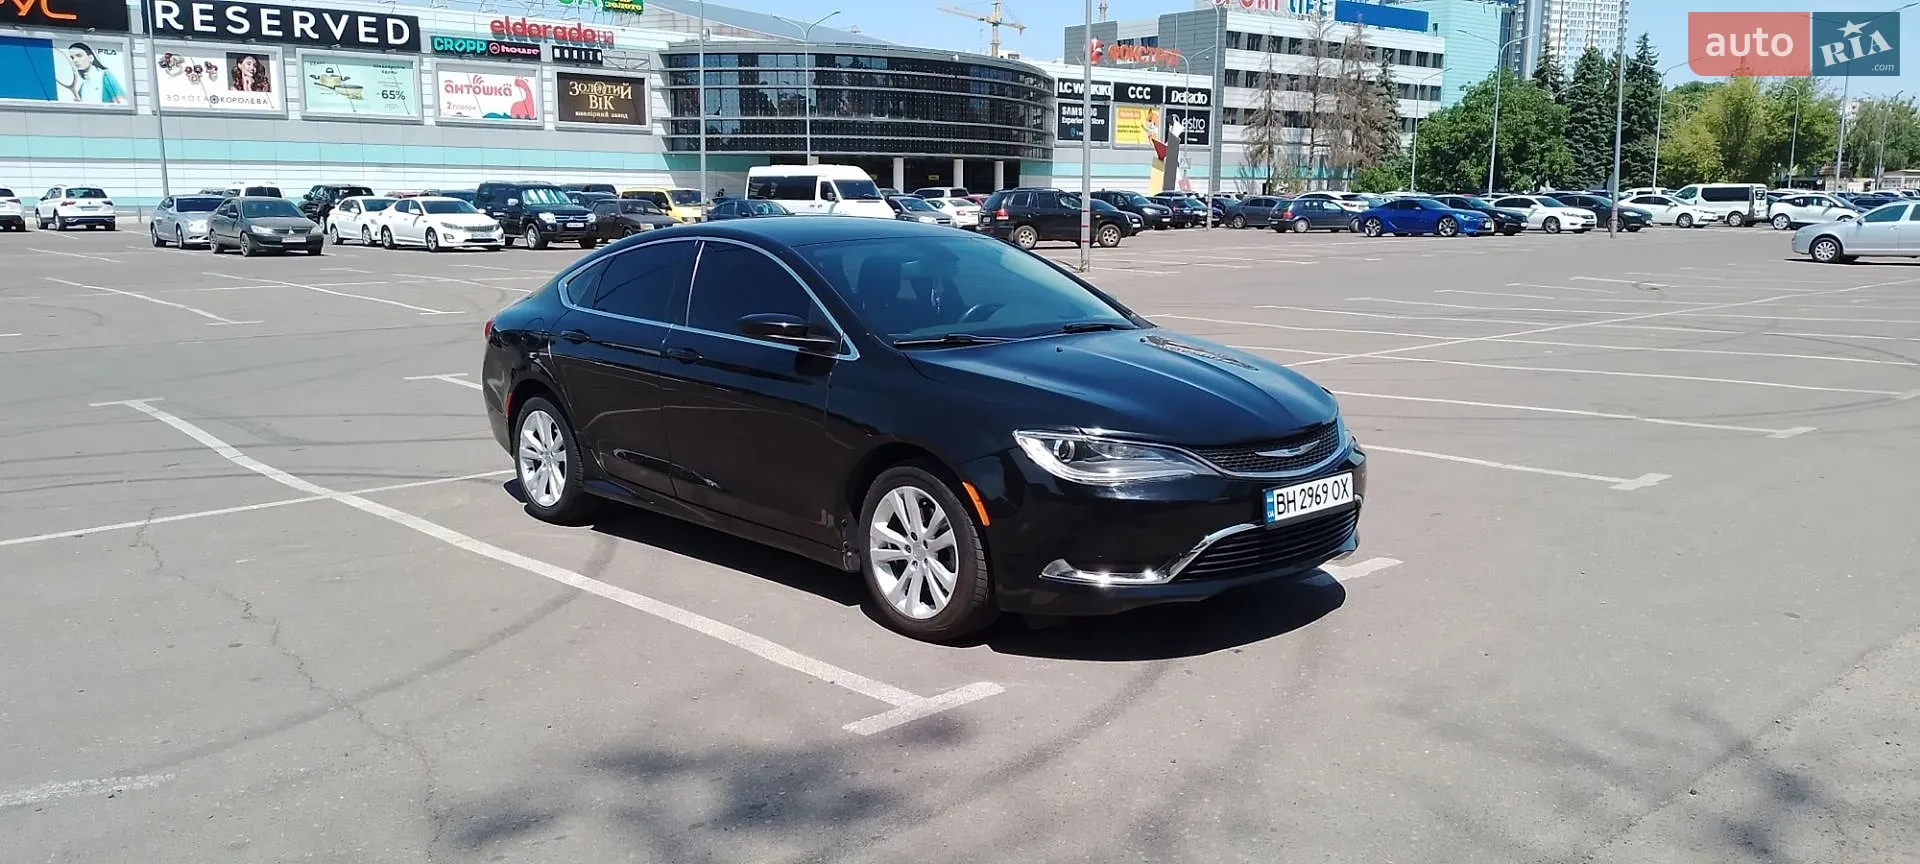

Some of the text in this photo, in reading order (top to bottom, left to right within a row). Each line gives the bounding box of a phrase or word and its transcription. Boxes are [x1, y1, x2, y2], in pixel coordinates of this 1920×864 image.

[155, 0, 411, 45] RESERVED
[433, 37, 487, 54] CROPP
[501, 45, 539, 55] house
[1059, 82, 1111, 96] LC WKIKI
[1128, 86, 1151, 100] CCC
[220, 96, 268, 105] КОРОЛЕВА
[1062, 106, 1097, 117] SAMSG
[1276, 477, 1349, 515] BH 2969 OX
